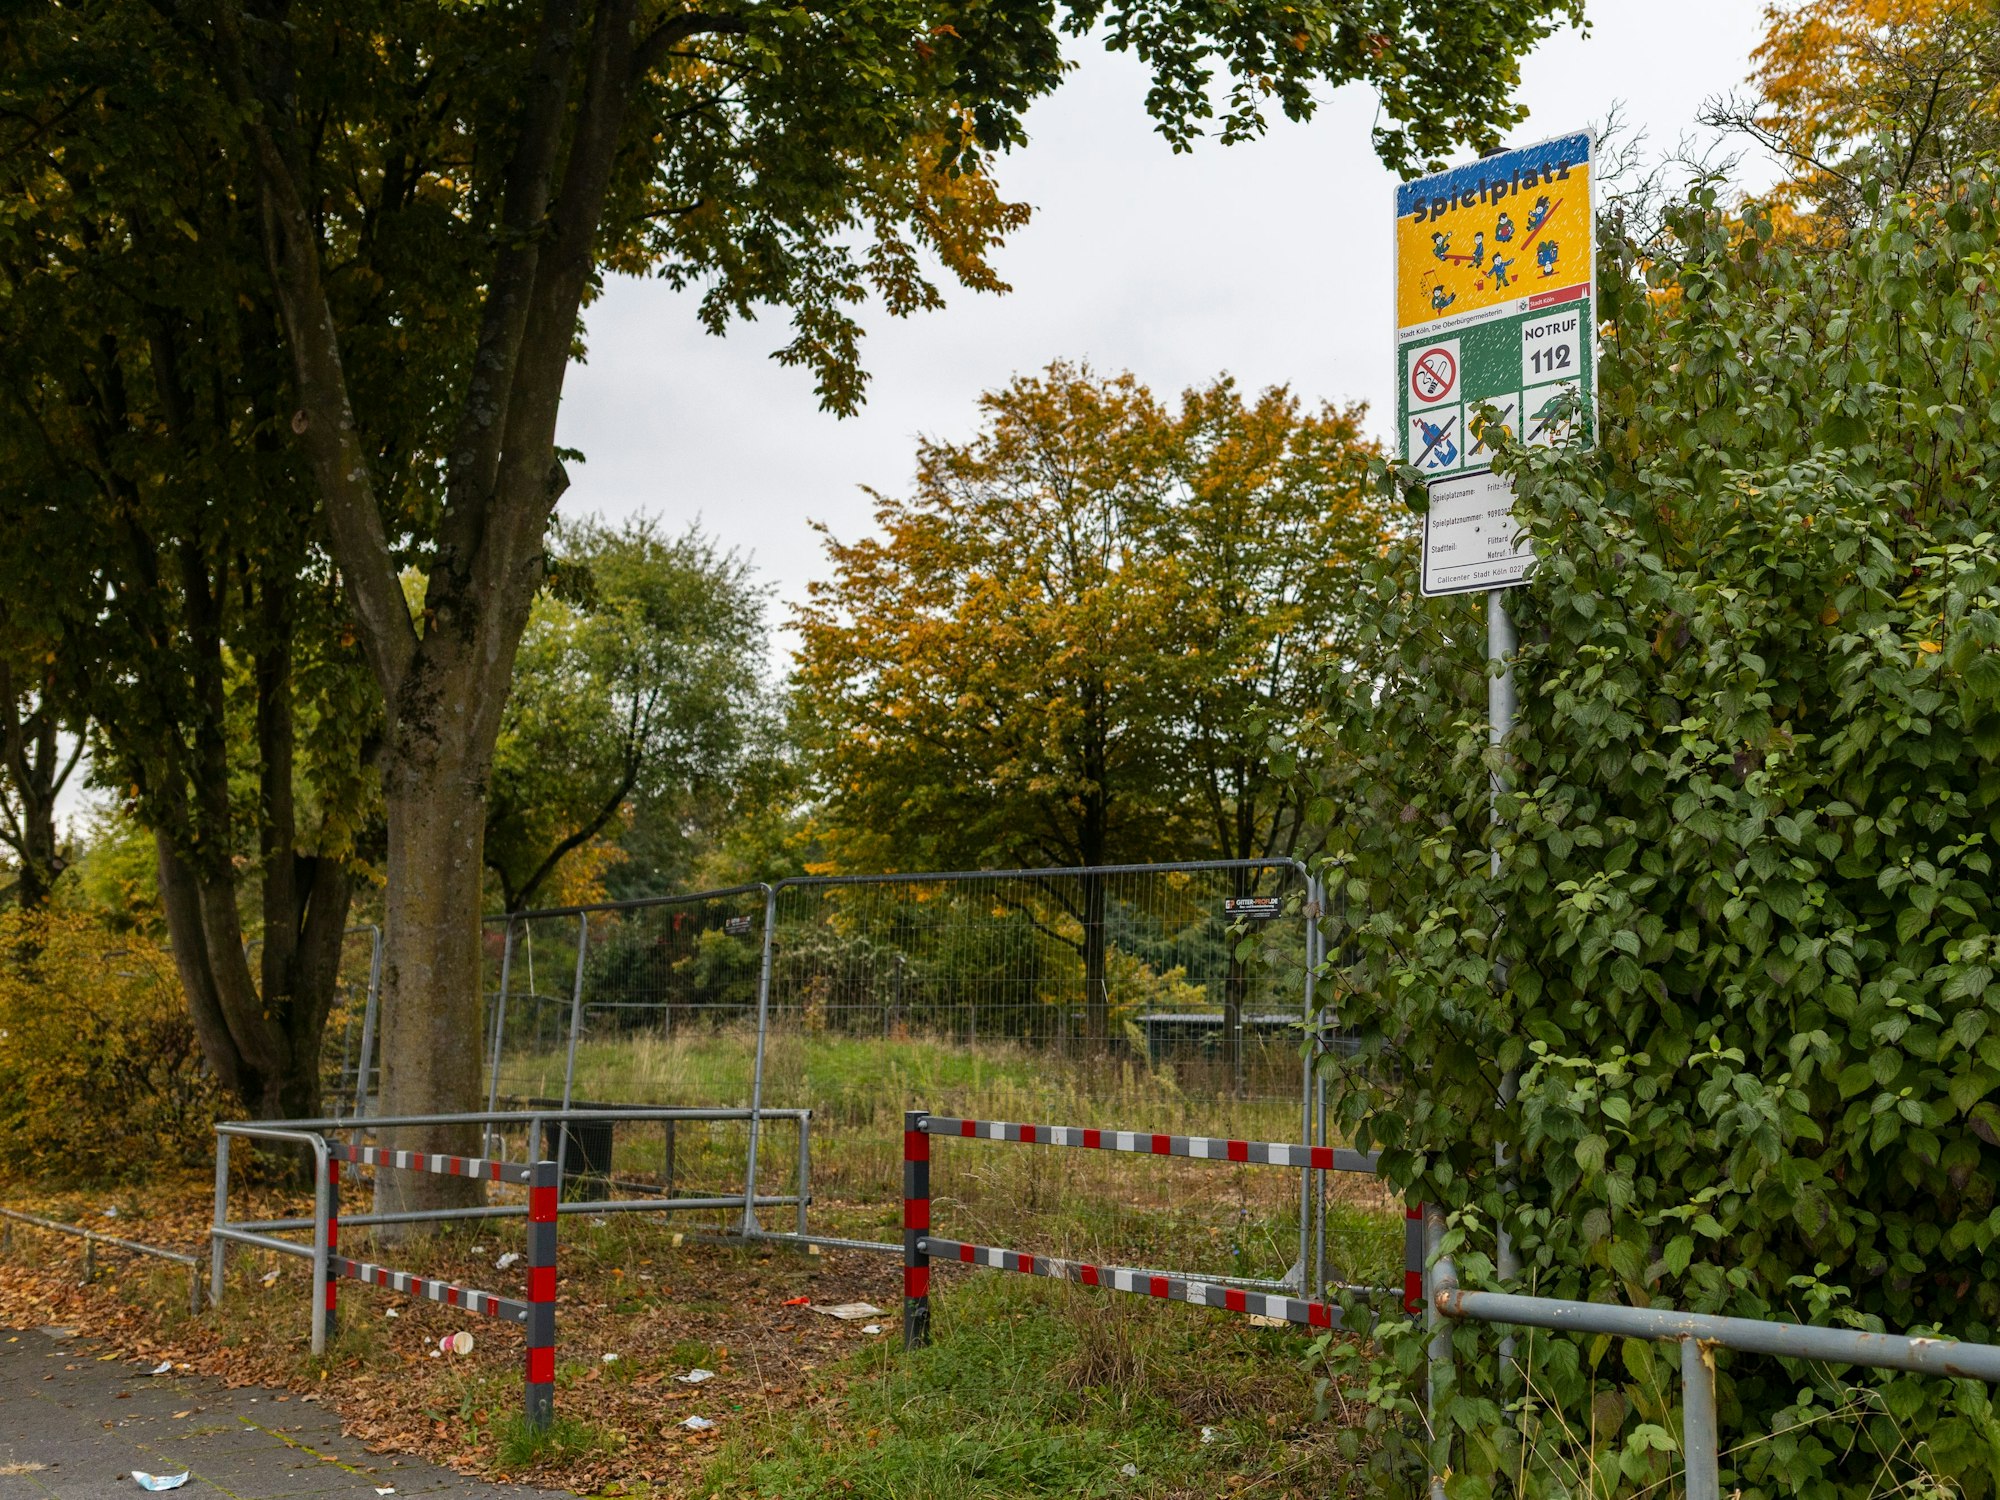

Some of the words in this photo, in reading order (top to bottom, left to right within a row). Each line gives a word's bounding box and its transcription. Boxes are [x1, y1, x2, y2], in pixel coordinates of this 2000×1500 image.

[1413, 159, 1572, 224] Spielplatz
[1529, 299, 1543, 308] Stadt
[1543, 296, 1555, 306] Köln
[1400, 328, 1415, 339] Stadt
[1416, 325, 1431, 337] Köln,
[1431, 322, 1442, 332] Die
[1442, 308, 1503, 330] Oberbürgermeisterin
[1525, 319, 1577, 342] NOTRUF
[1530, 344, 1571, 374] 112
[1432, 489, 1476, 503] Spielplatzname:
[1432, 513, 1484, 528] Spielplatznummer:
[1431, 543, 1457, 554] Stadtteil:
[1437, 573, 1470, 584] Callcenter
[1473, 570, 1490, 579] Stadt
[1492, 567, 1507, 577] Köln
